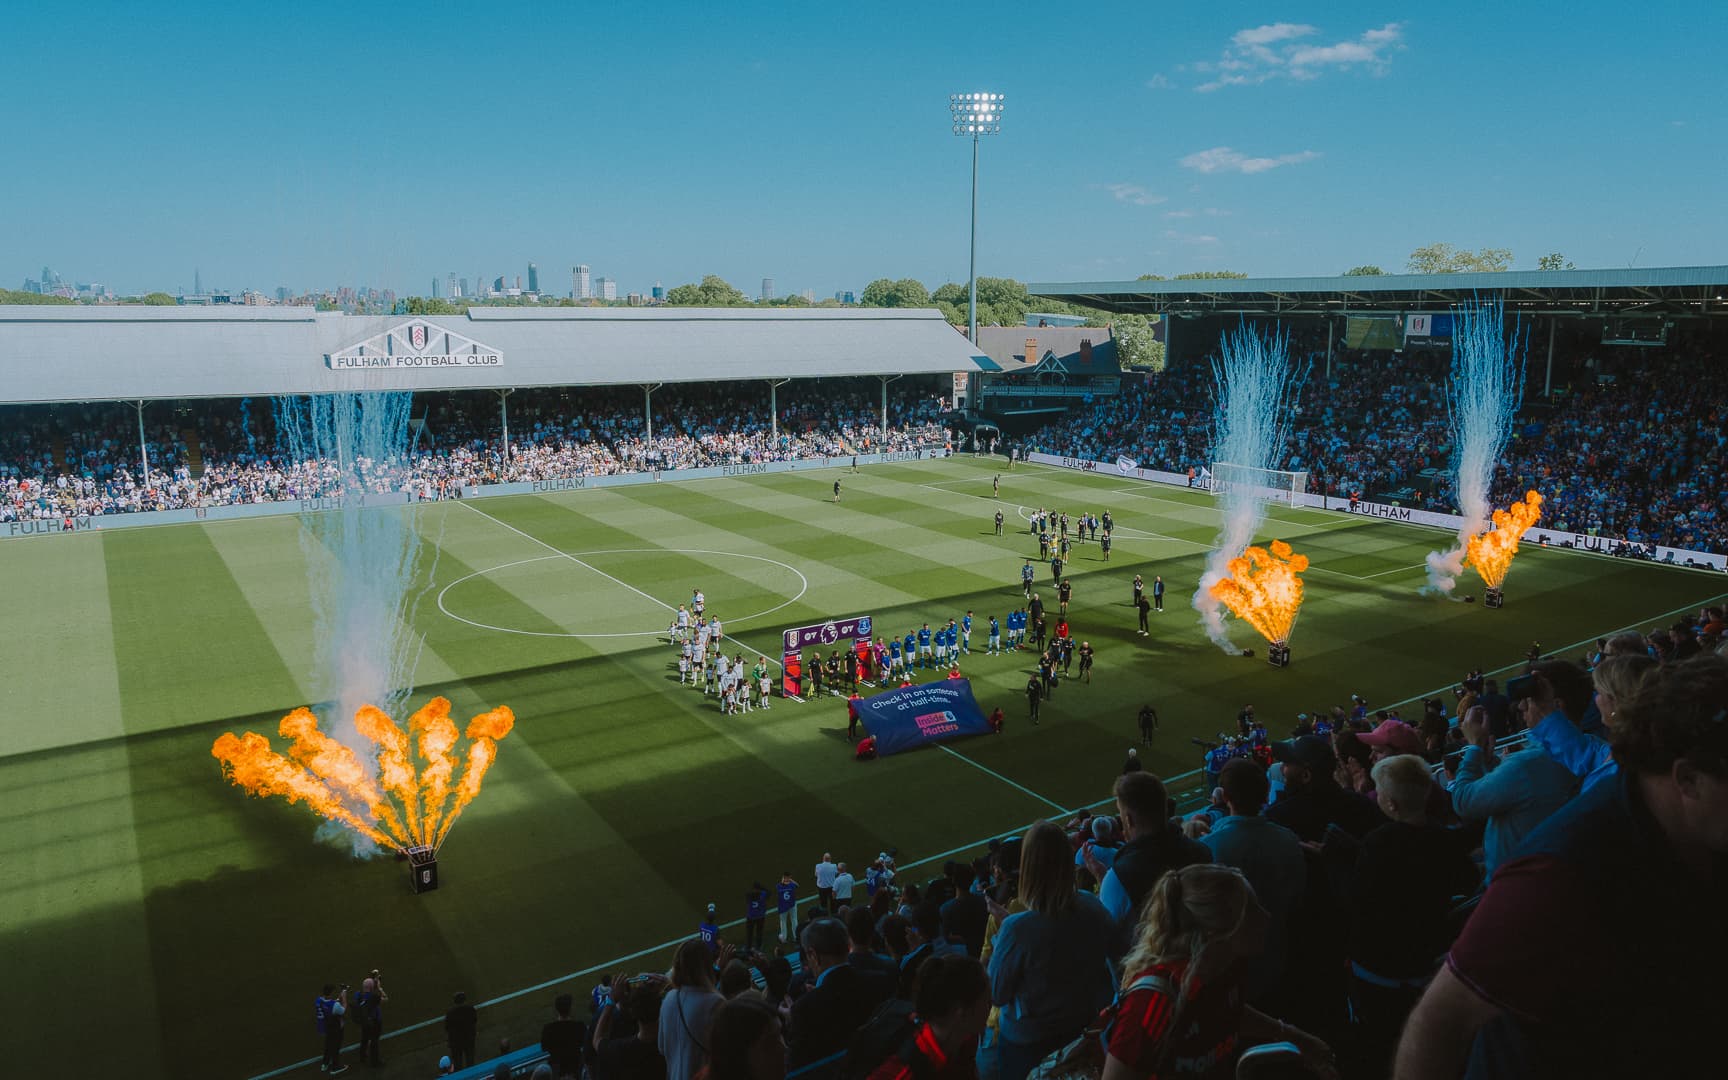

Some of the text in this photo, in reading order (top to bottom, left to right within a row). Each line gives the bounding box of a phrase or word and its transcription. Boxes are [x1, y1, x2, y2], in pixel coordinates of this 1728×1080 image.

[337, 355, 498, 367] FULHAM FOOTBALL CLUB
[722, 463, 767, 476] FULHAM
[532, 478, 585, 492] FULHAM
[1354, 500, 1411, 521] FULHAM
[9, 517, 91, 536] FULHM
[872, 695, 902, 709] Check
[901, 692, 912, 700] in
[897, 702, 910, 711] at
[917, 714, 945, 727] Inside
[922, 723, 959, 737] Matters
[783, 890, 791, 901] 6
[701, 931, 712, 942] 10
